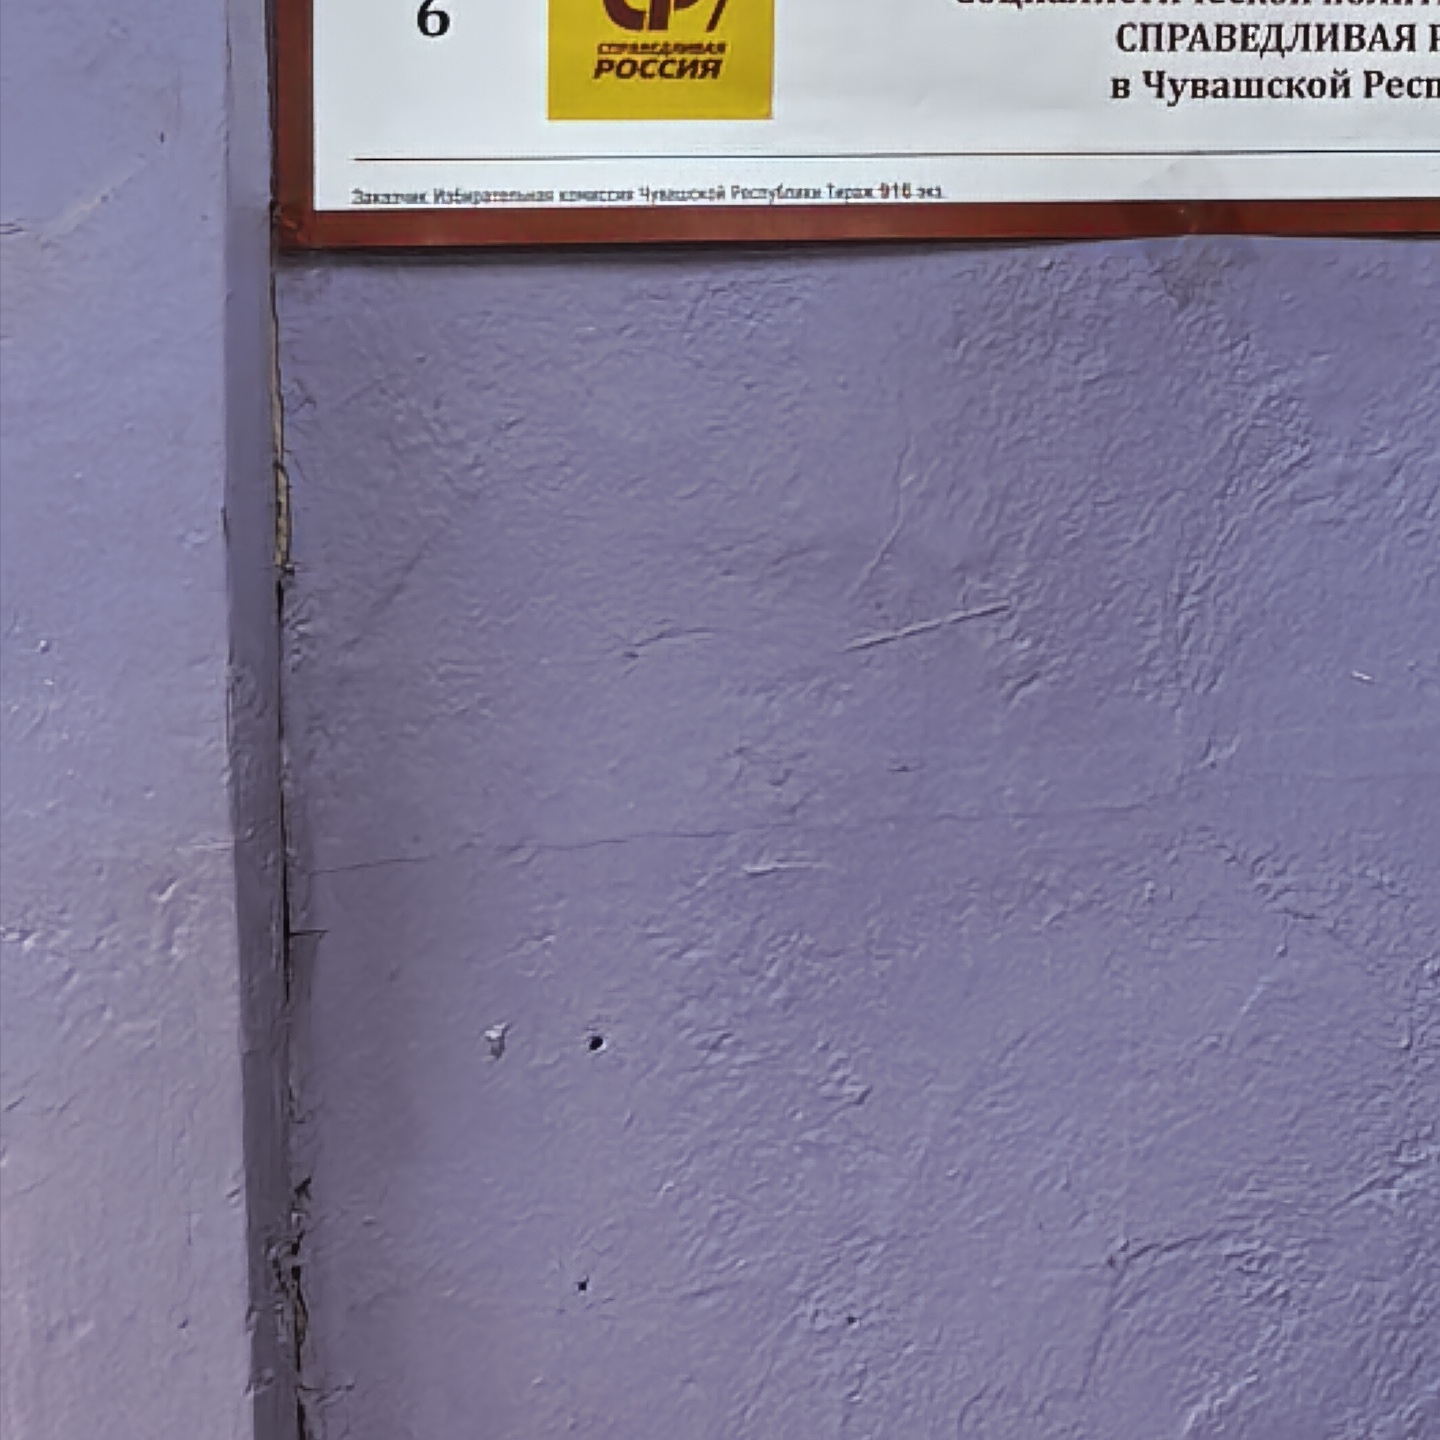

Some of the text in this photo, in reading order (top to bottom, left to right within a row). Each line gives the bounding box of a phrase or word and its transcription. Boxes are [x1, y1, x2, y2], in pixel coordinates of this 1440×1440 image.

[1115, 17, 1419, 61] СПРАВЕДЛИВАЯ
[593, 58, 723, 80] РОССИЯ
[1109, 74, 1131, 100] в
[1141, 67, 1354, 108] Чувашской
